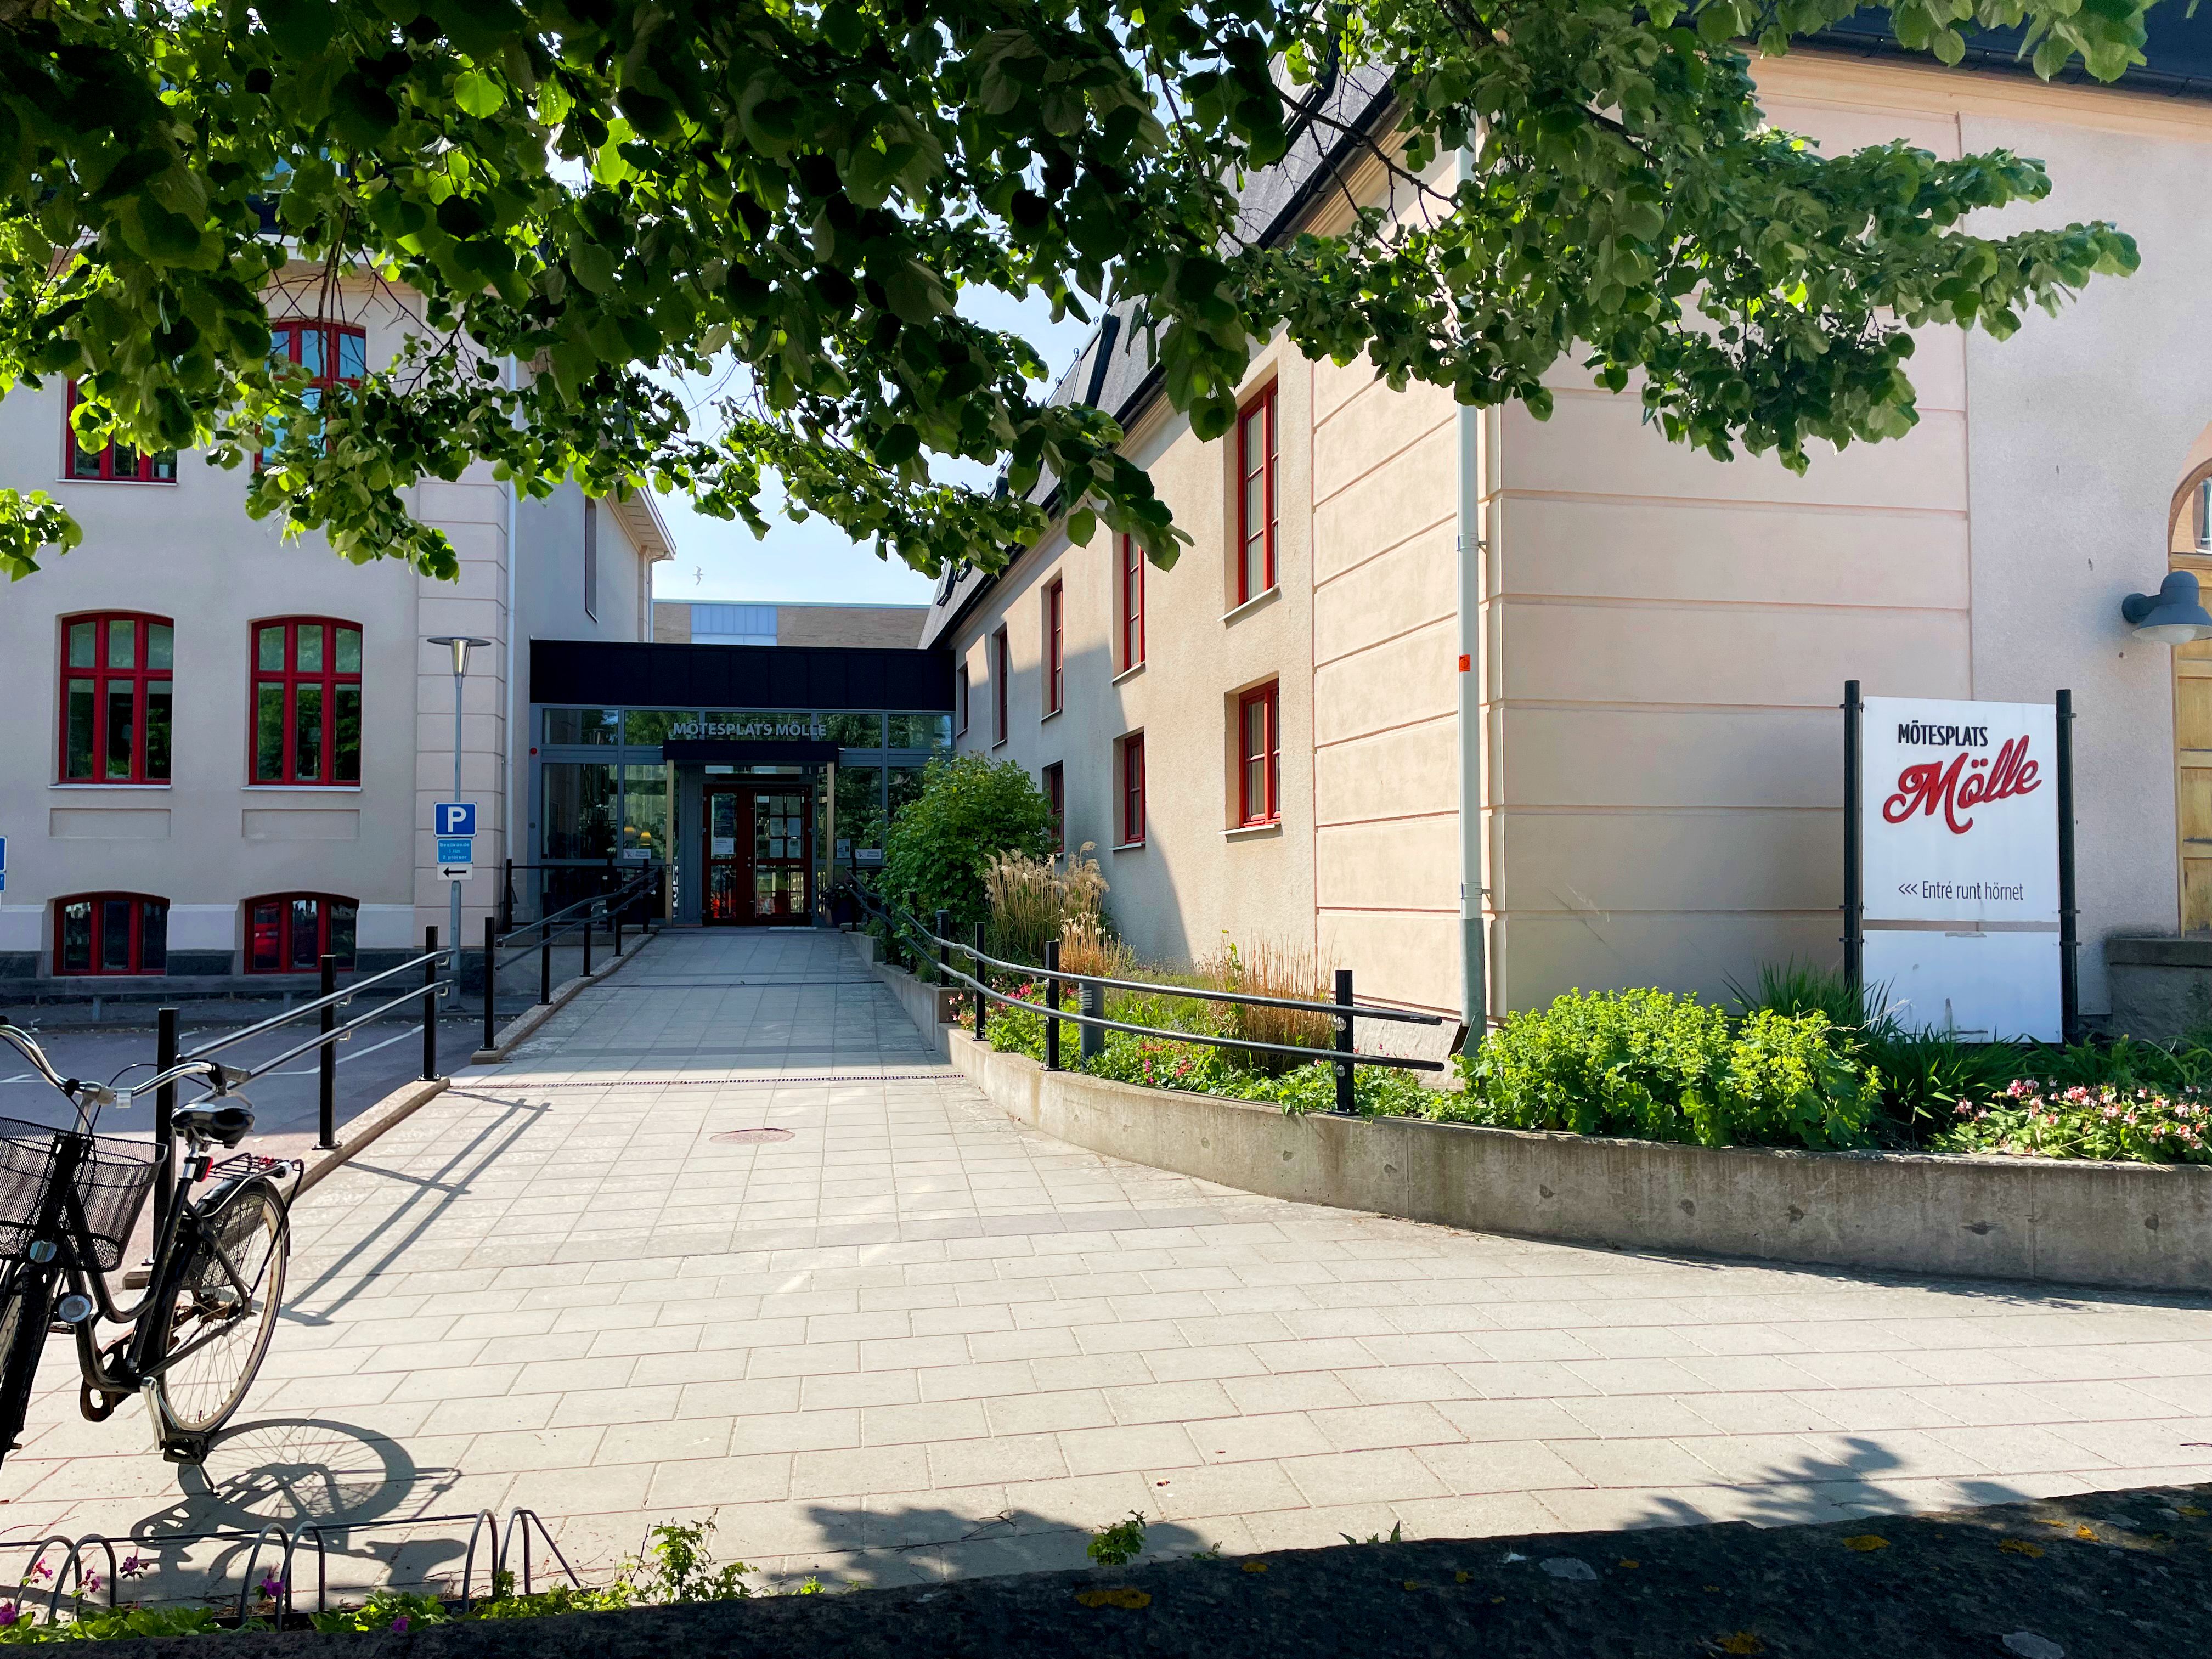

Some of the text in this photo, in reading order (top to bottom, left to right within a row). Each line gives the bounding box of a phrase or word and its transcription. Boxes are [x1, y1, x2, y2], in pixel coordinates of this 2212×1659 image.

[673, 719, 827, 736] MÖTESPLATS MÖLLE
[1898, 720, 1988, 747] MÖTESPLATS
[1883, 734, 2042, 834] Mölle
[448, 806, 466, 832] P
[1922, 881, 1953, 899] Entré
[1956, 882, 1982, 900] runt
[1985, 882, 2024, 900] hörnet
